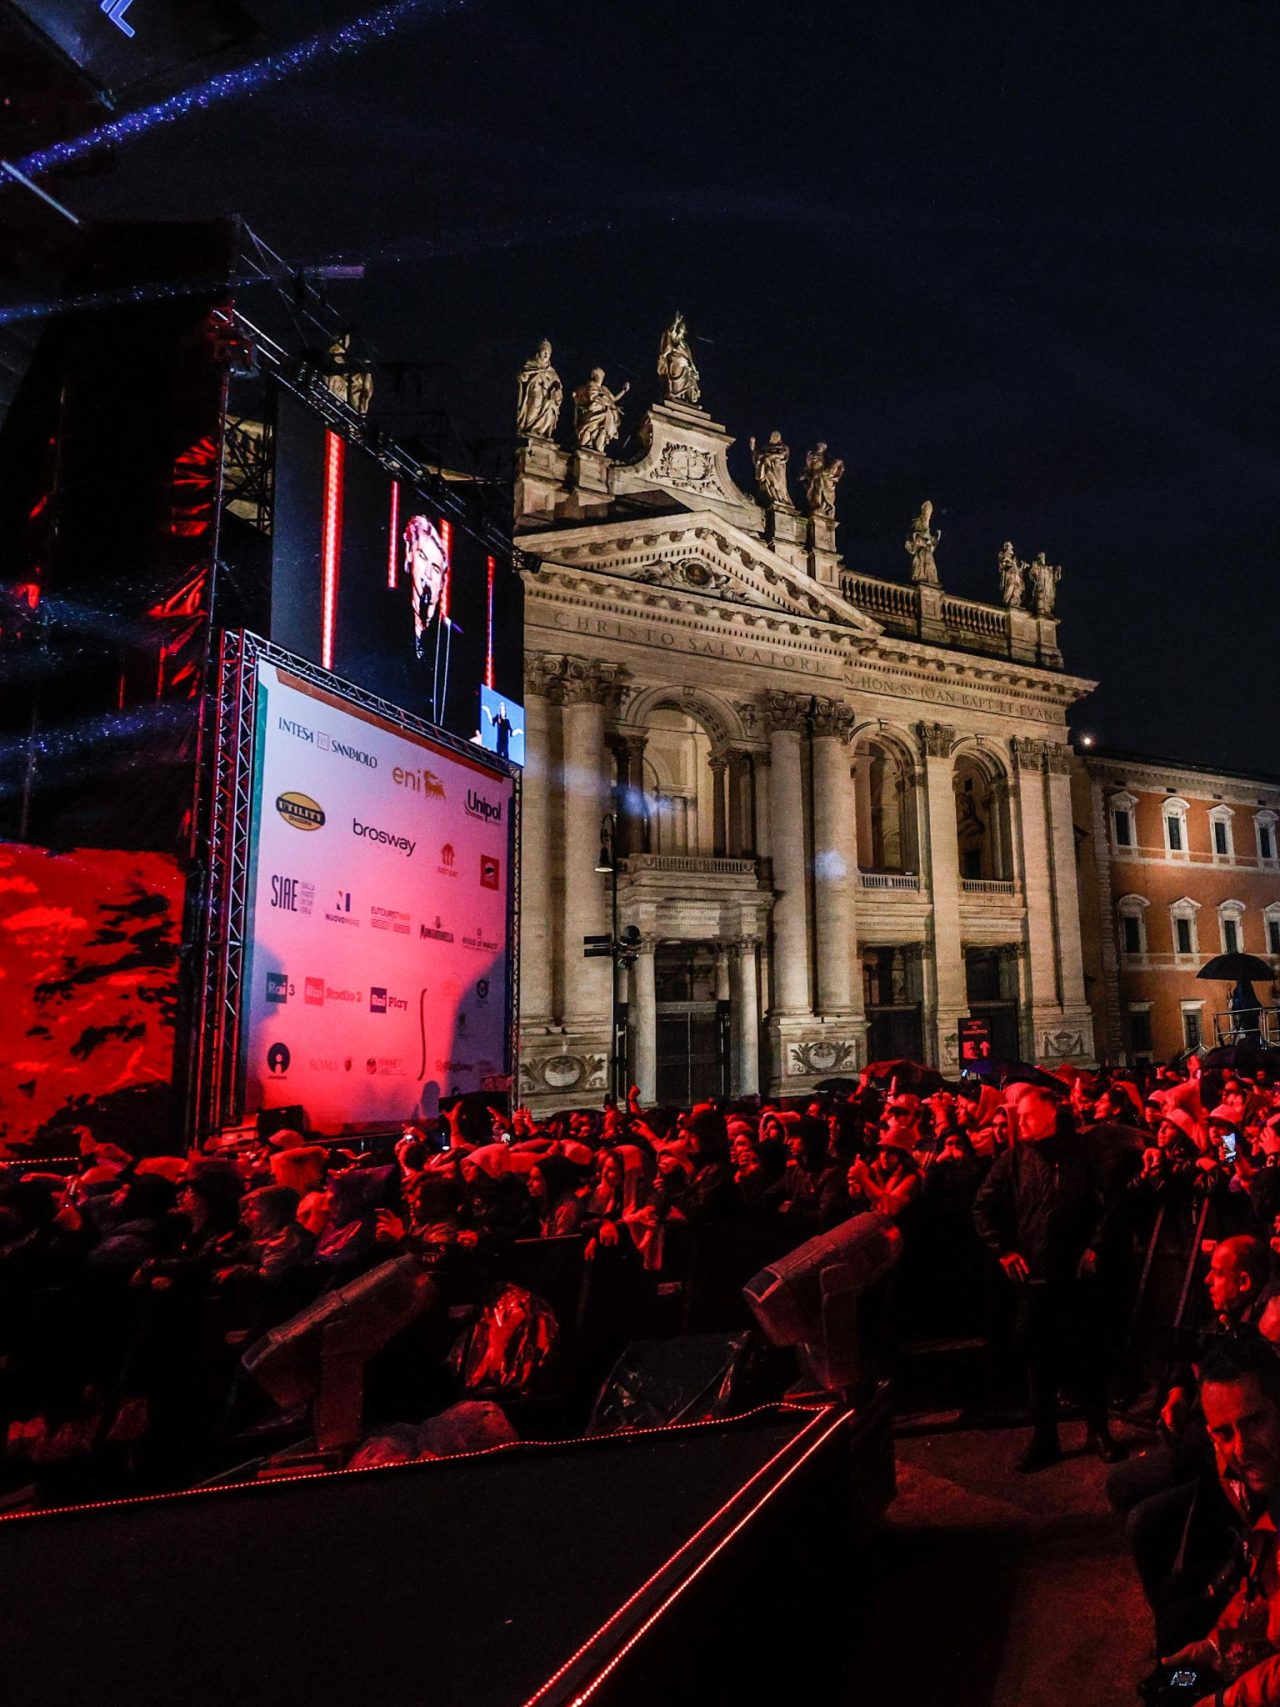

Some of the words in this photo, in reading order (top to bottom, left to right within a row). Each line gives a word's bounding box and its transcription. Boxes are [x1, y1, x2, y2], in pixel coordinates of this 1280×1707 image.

[554, 612, 675, 646] CHRISTO
[687, 637, 821, 672] SALVATORI
[278, 717, 315, 743] INTESA
[331, 740, 378, 769] SANPAOLO
[392, 767, 421, 793] eni
[468, 789, 501, 822] Unipol
[353, 818, 416, 857] brosway
[271, 874, 299, 912] SIAE
